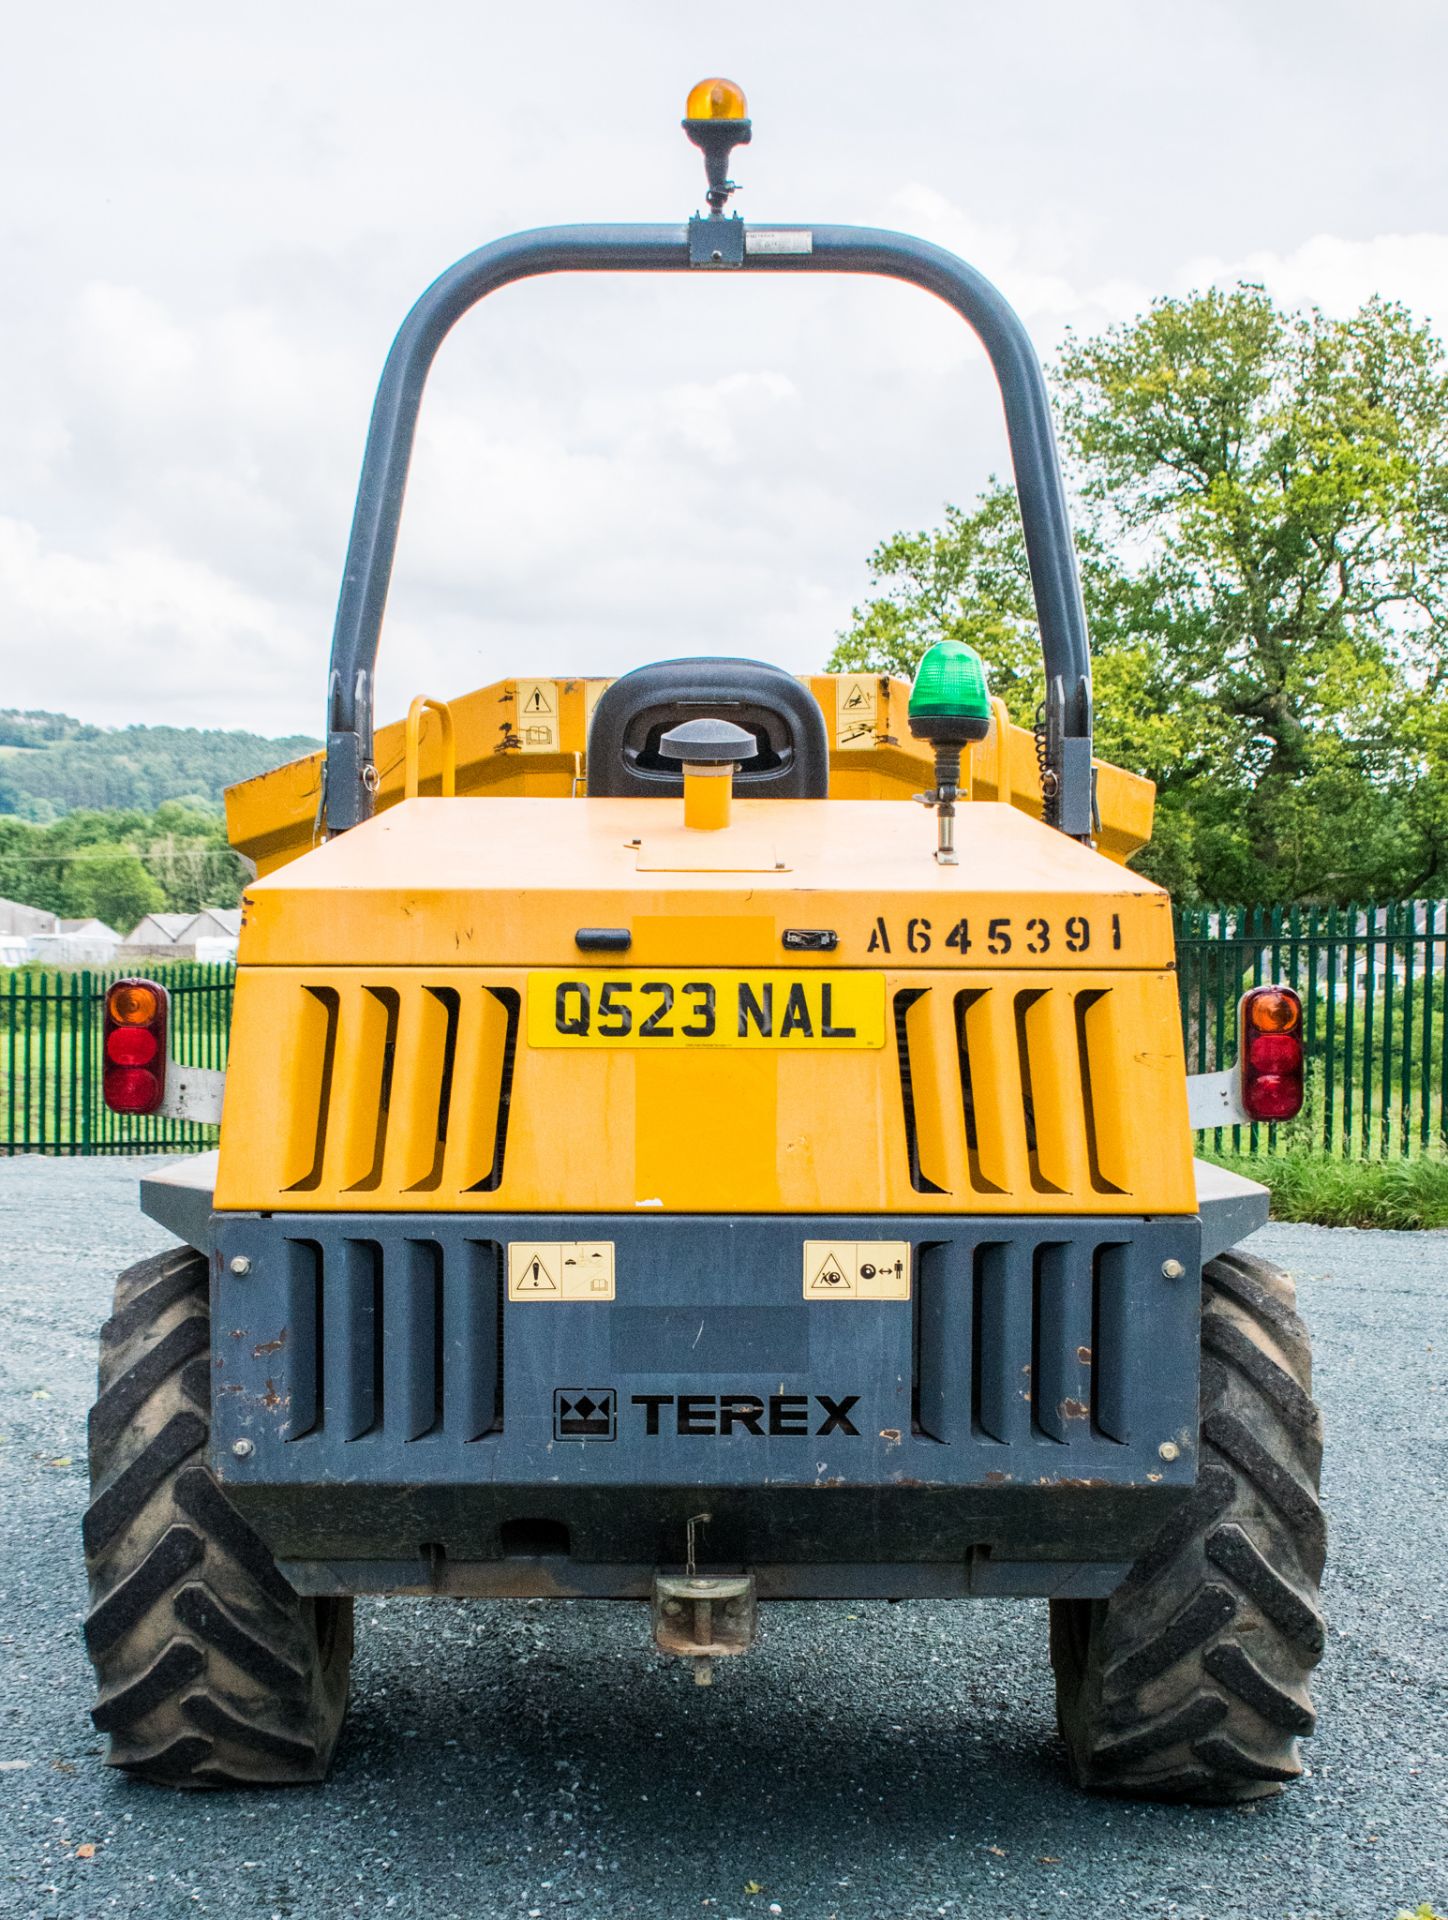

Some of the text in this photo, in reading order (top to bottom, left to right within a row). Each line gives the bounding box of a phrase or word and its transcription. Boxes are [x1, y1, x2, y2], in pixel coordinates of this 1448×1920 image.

[555, 981, 857, 1038] Q523 NAL
[631, 1394, 862, 1436] TEREX
